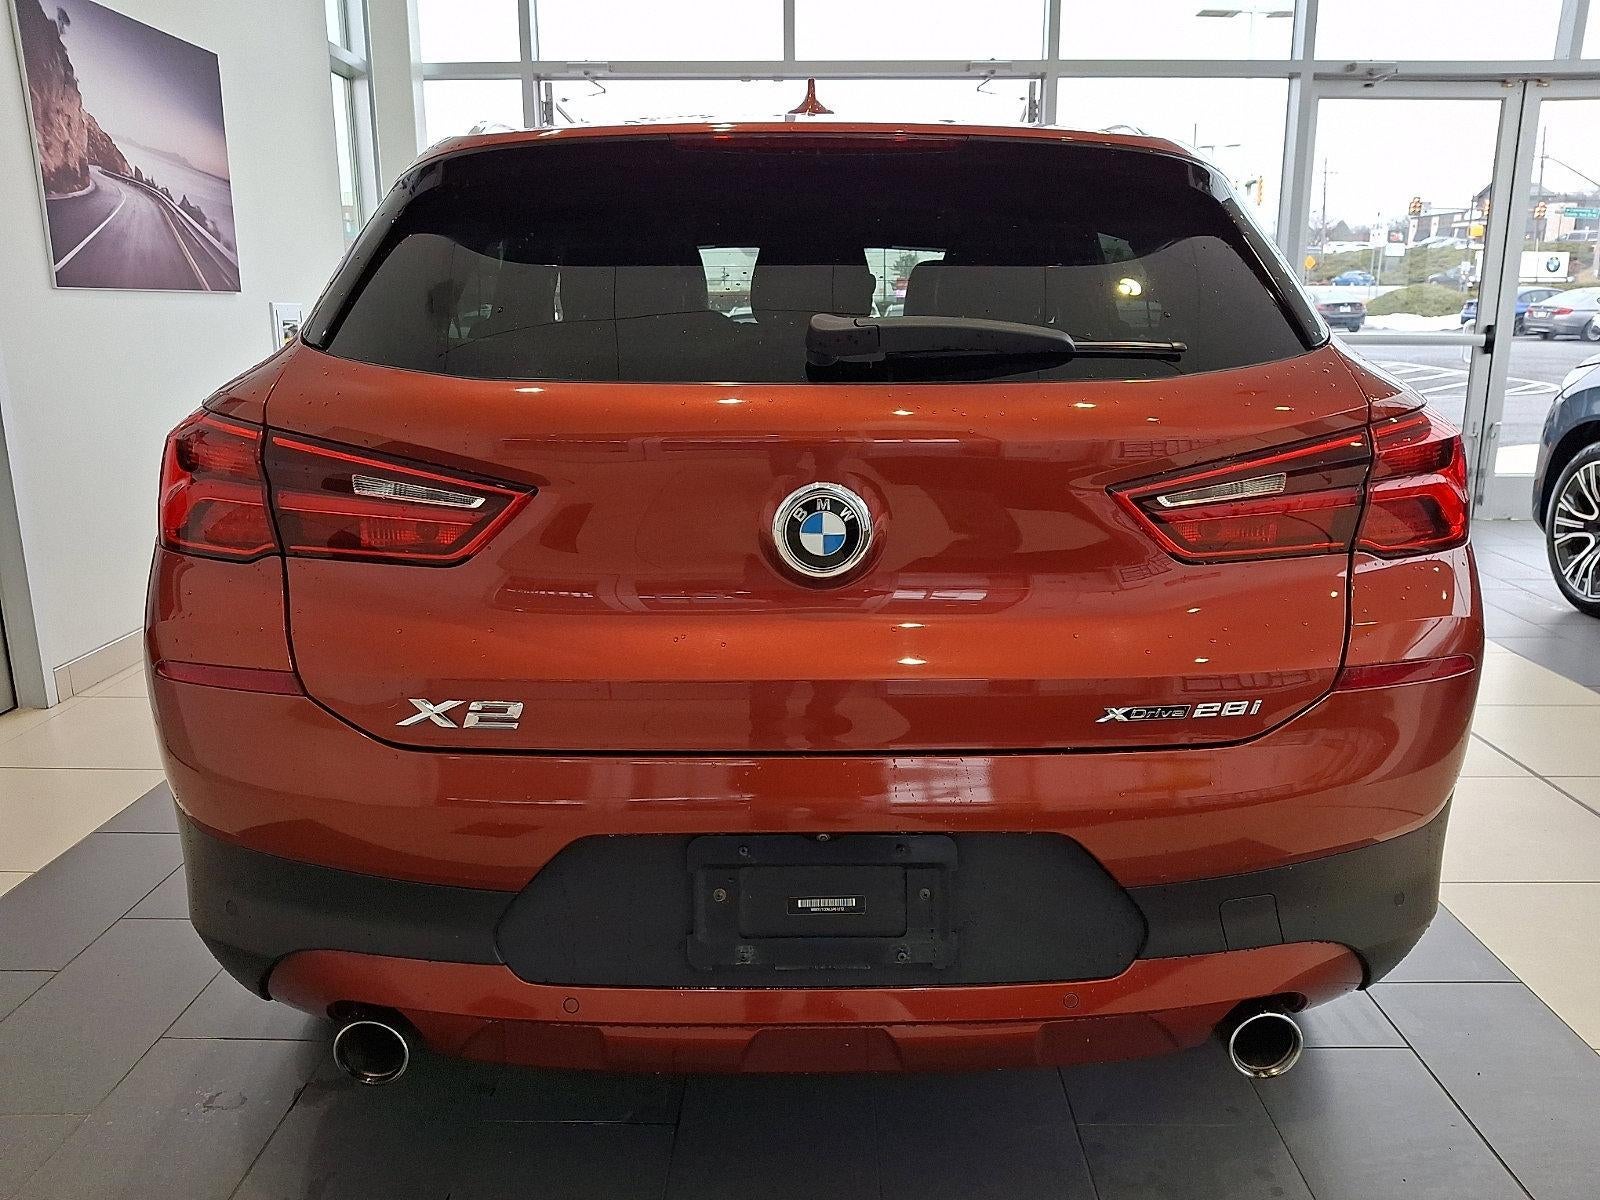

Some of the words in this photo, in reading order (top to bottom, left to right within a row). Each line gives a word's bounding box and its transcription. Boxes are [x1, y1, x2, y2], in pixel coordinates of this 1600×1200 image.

[793, 498, 855, 523] BMW
[395, 698, 524, 730] X2
[1192, 699, 1263, 718] 28i
